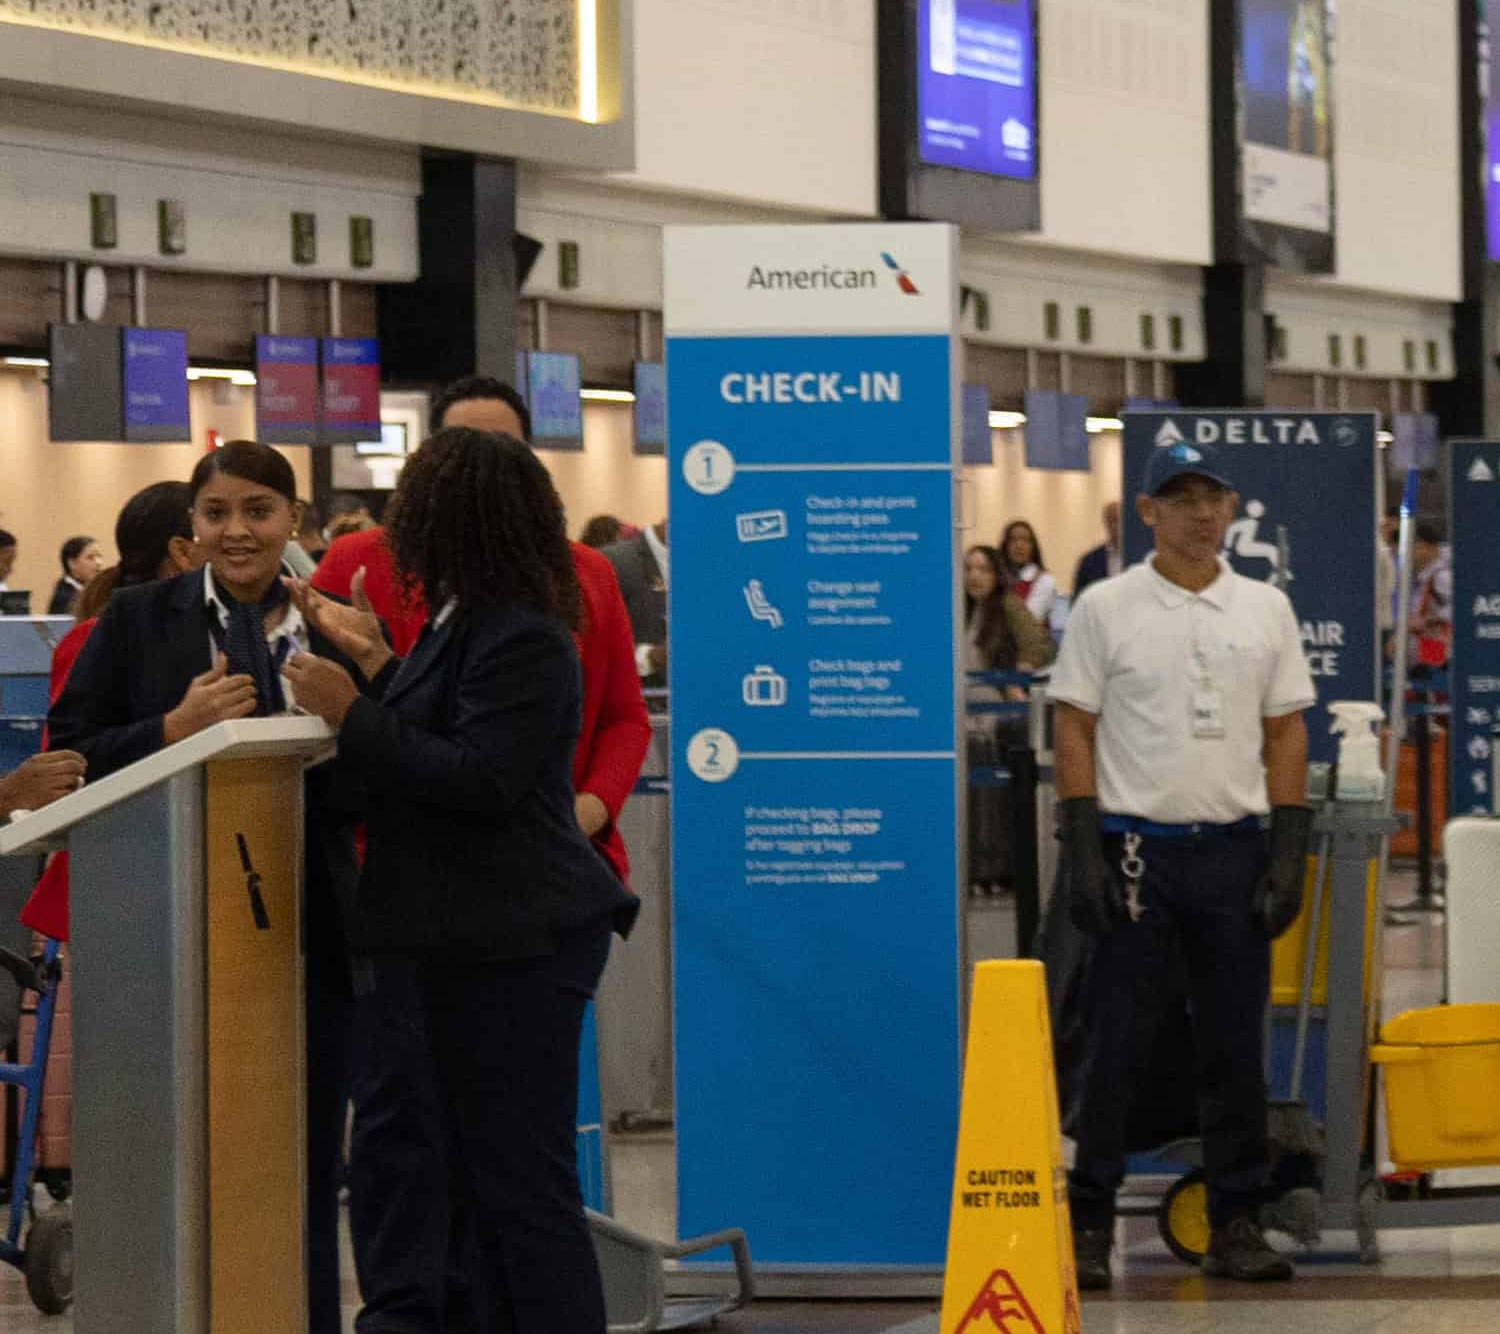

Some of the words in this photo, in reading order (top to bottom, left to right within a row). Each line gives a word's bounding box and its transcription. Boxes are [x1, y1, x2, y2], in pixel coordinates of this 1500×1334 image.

[747, 265, 877, 289] American
[720, 371, 901, 404] CHECK-IN
[1195, 418, 1320, 445] DELTA
[702, 456, 713, 479] 1
[705, 741, 720, 766] 2
[968, 1169, 1036, 1186] CAUTION
[962, 1191, 992, 1208] WET
[995, 1191, 1041, 1208] FLOOR
